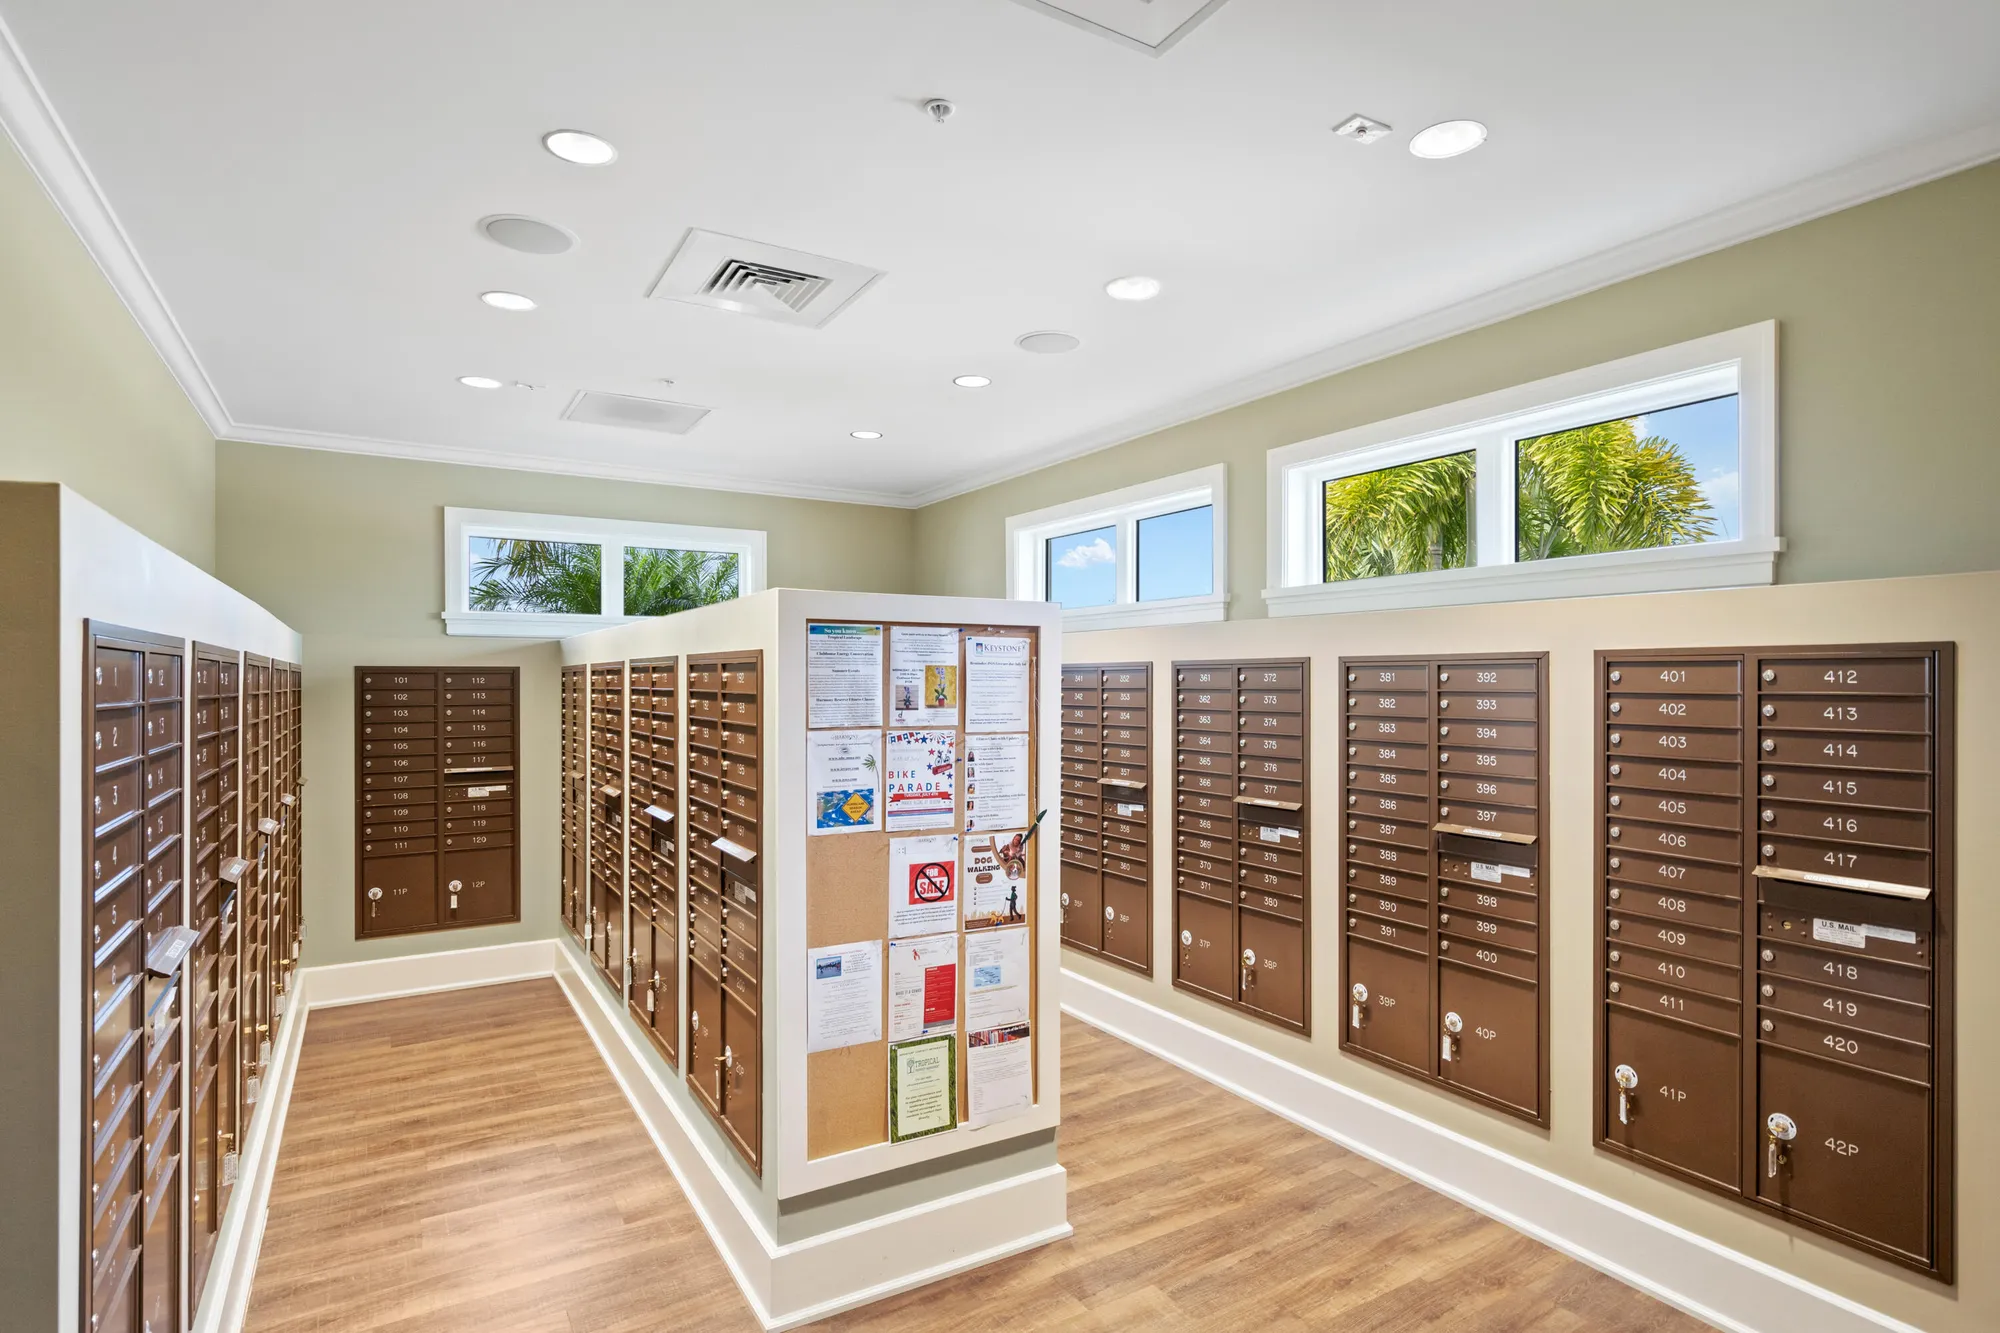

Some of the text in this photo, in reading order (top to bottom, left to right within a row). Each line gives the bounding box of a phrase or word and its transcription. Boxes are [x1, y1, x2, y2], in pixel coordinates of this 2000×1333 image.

[984, 644, 1021, 652] KEYSTONE
[114, 668, 118, 686] 1
[158, 670, 164, 686] 12
[1264, 673, 1276, 681] 372
[1380, 673, 1394, 682] 381
[1477, 672, 1496, 682] 392
[1660, 671, 1686, 682] 401
[1824, 670, 1857, 683] 412
[1264, 696, 1277, 704] 373
[1379, 699, 1395, 708] 382
[1477, 700, 1496, 710] 393
[1659, 703, 1686, 715] 402
[1824, 707, 1857, 720] 413
[1264, 718, 1277, 726] 374
[1379, 723, 1396, 733] 383
[113, 726, 118, 746] 2
[1477, 728, 1497, 738] 394
[1264, 740, 1277, 749] 375
[1659, 736, 1686, 748] 403
[1379, 749, 1396, 758] 384
[1824, 744, 1857, 757] 414
[1199, 757, 1211, 765] 365
[1477, 755, 1496, 766] 395
[1264, 763, 1277, 772] 376
[888, 770, 916, 779] BIKE
[1380, 774, 1396, 784] 385
[1659, 768, 1686, 780] 404
[889, 782, 940, 792] PARADE
[1264, 785, 1277, 793] 377
[1477, 783, 1496, 794] 396
[1823, 781, 1857, 795] 415
[113, 786, 118, 805] 3
[1380, 799, 1396, 810] 386
[1659, 801, 1686, 814] 405
[1477, 811, 1496, 821] 397
[158, 816, 164, 833] 15
[1380, 824, 1396, 834] 387
[1824, 817, 1857, 832] 416
[1659, 833, 1686, 847] 406
[112, 846, 117, 865] 4
[1264, 852, 1277, 862] 378
[1380, 850, 1396, 861] 388
[1824, 852, 1857, 867] 417
[1200, 861, 1211, 870] 370
[1659, 865, 1685, 879] 407
[1265, 874, 1277, 884] 379
[1380, 875, 1396, 886] 389
[920, 880, 944, 894] SALE
[1201, 881, 1210, 890] 371
[1264, 897, 1277, 907] 380
[1380, 900, 1396, 912] 390
[1477, 894, 1497, 907] 398
[1658, 897, 1685, 912] 408
[112, 905, 116, 924] 5
[1381, 925, 1395, 937] 391
[1477, 921, 1496, 934] 399
[1822, 920, 1856, 932] U.S. MAIL
[1199, 939, 1210, 948] 37P
[1658, 930, 1685, 945] 409
[1476, 950, 1497, 963] 400
[1264, 959, 1277, 969] 38P
[1658, 963, 1685, 978] 410
[1824, 962, 1857, 979] 418
[1379, 995, 1395, 1007] 39P
[1660, 996, 1684, 1010] 411
[1823, 999, 1857, 1016] 419
[1476, 1027, 1496, 1040] 40P
[1824, 1035, 1858, 1054] 420
[915, 1057, 940, 1068] TROPICAL
[1660, 1086, 1686, 1101] 41P
[1825, 1138, 1858, 1156] 42P
